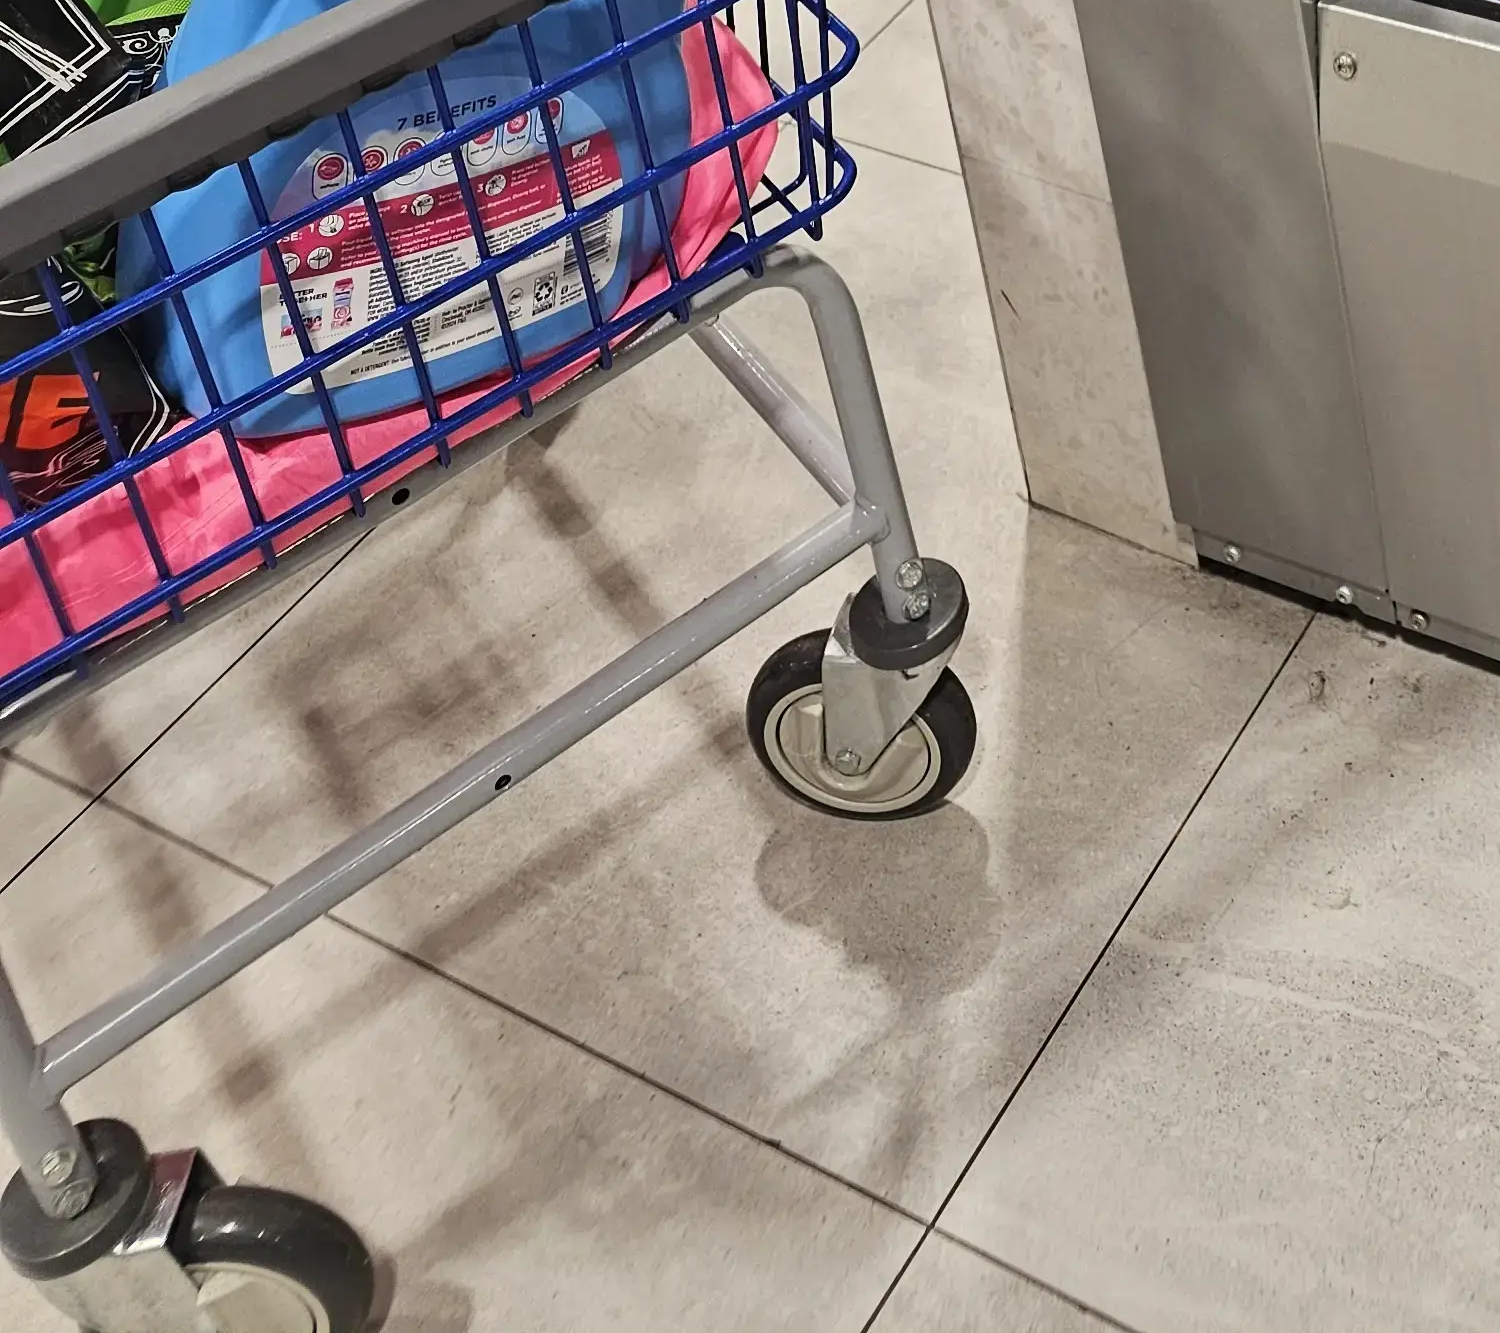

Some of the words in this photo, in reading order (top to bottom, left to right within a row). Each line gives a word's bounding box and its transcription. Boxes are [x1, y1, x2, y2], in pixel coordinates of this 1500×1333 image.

[397, 117, 408, 131] 7
[413, 95, 497, 127] BEEFITS
[400, 204, 408, 214] 2
